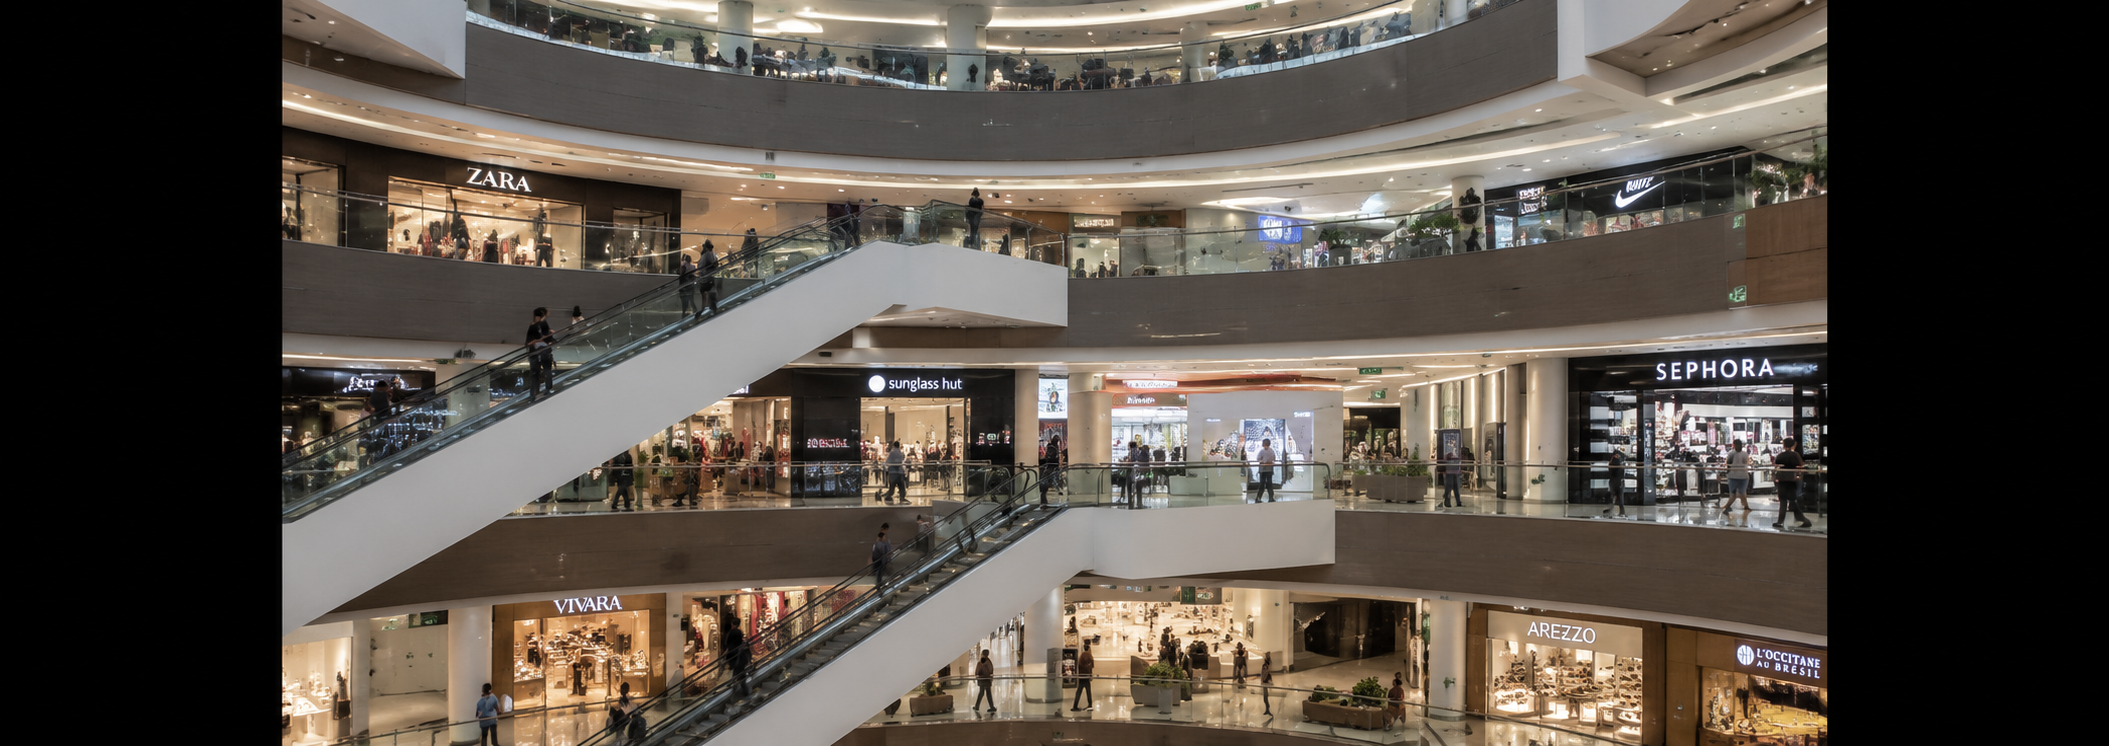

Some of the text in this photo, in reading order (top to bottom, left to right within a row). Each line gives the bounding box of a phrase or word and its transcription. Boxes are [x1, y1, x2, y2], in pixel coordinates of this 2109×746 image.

[467, 167, 531, 192] ZARA
[1656, 358, 1774, 381] SEPHORA
[889, 377, 962, 392] sunglass hut
[554, 595, 622, 614] VIVARA
[1527, 621, 1596, 644] AREZZO
[1756, 648, 1820, 668] L'OCCITANE
[1756, 660, 1769, 669] AU
